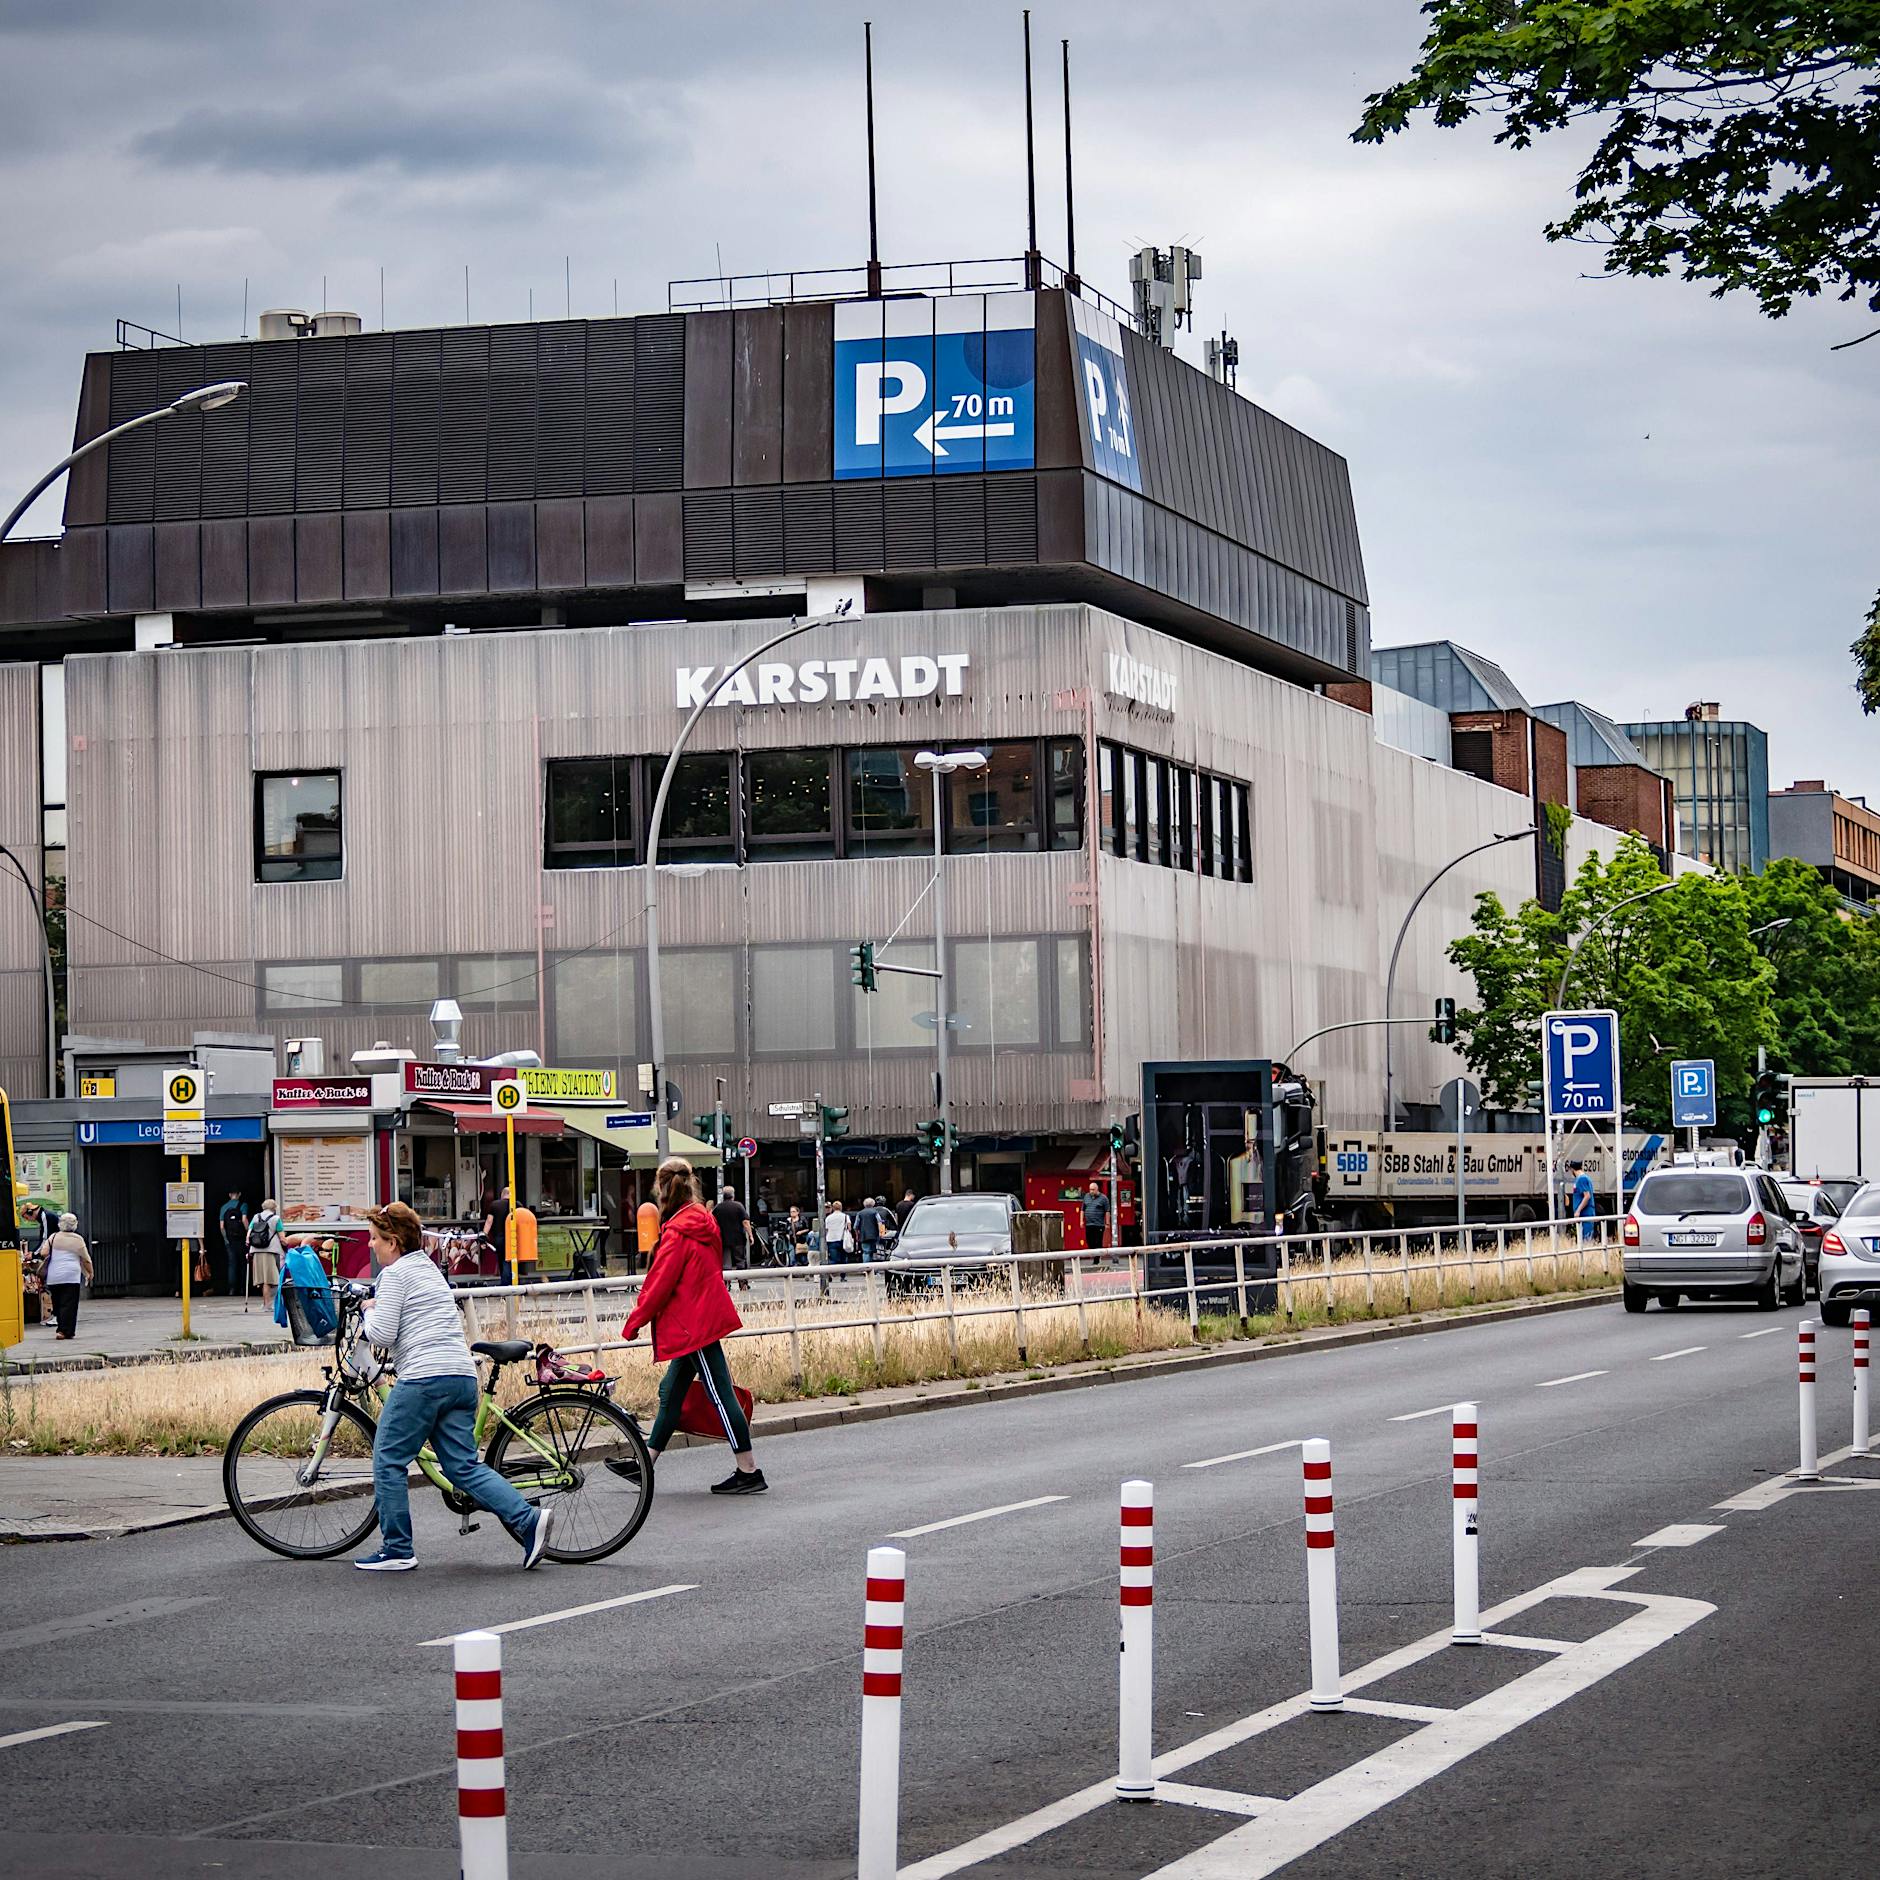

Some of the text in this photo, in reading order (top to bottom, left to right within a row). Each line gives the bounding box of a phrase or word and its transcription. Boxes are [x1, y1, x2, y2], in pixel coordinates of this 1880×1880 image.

[856, 360, 927, 446] P
[952, 394, 1014, 418] 70 m
[1084, 358, 1107, 442] P
[676, 654, 970, 708] KARSTADT
[1109, 652, 1177, 714] KARSTADT
[1563, 1024, 1599, 1078] P
[176, 1082, 189, 1097] H
[414, 1067, 441, 1090] Kaffee
[442, 1068, 449, 1090] &
[449, 1069, 471, 1091] Back
[562, 1073, 601, 1096] STATION
[1683, 1072, 1698, 1093] P
[277, 1088, 312, 1100] Kaffee
[314, 1088, 324, 1100] &
[325, 1087, 355, 1098] Back
[502, 1090, 514, 1104] H
[1562, 1093, 1604, 1108] 70 m
[80, 1123, 95, 1143] U
[1337, 1153, 1368, 1172] SBB
[1384, 1154, 1523, 1173] SBB Stahl & Bau GmbH
[1622, 1147, 1658, 1160] etonstahl
